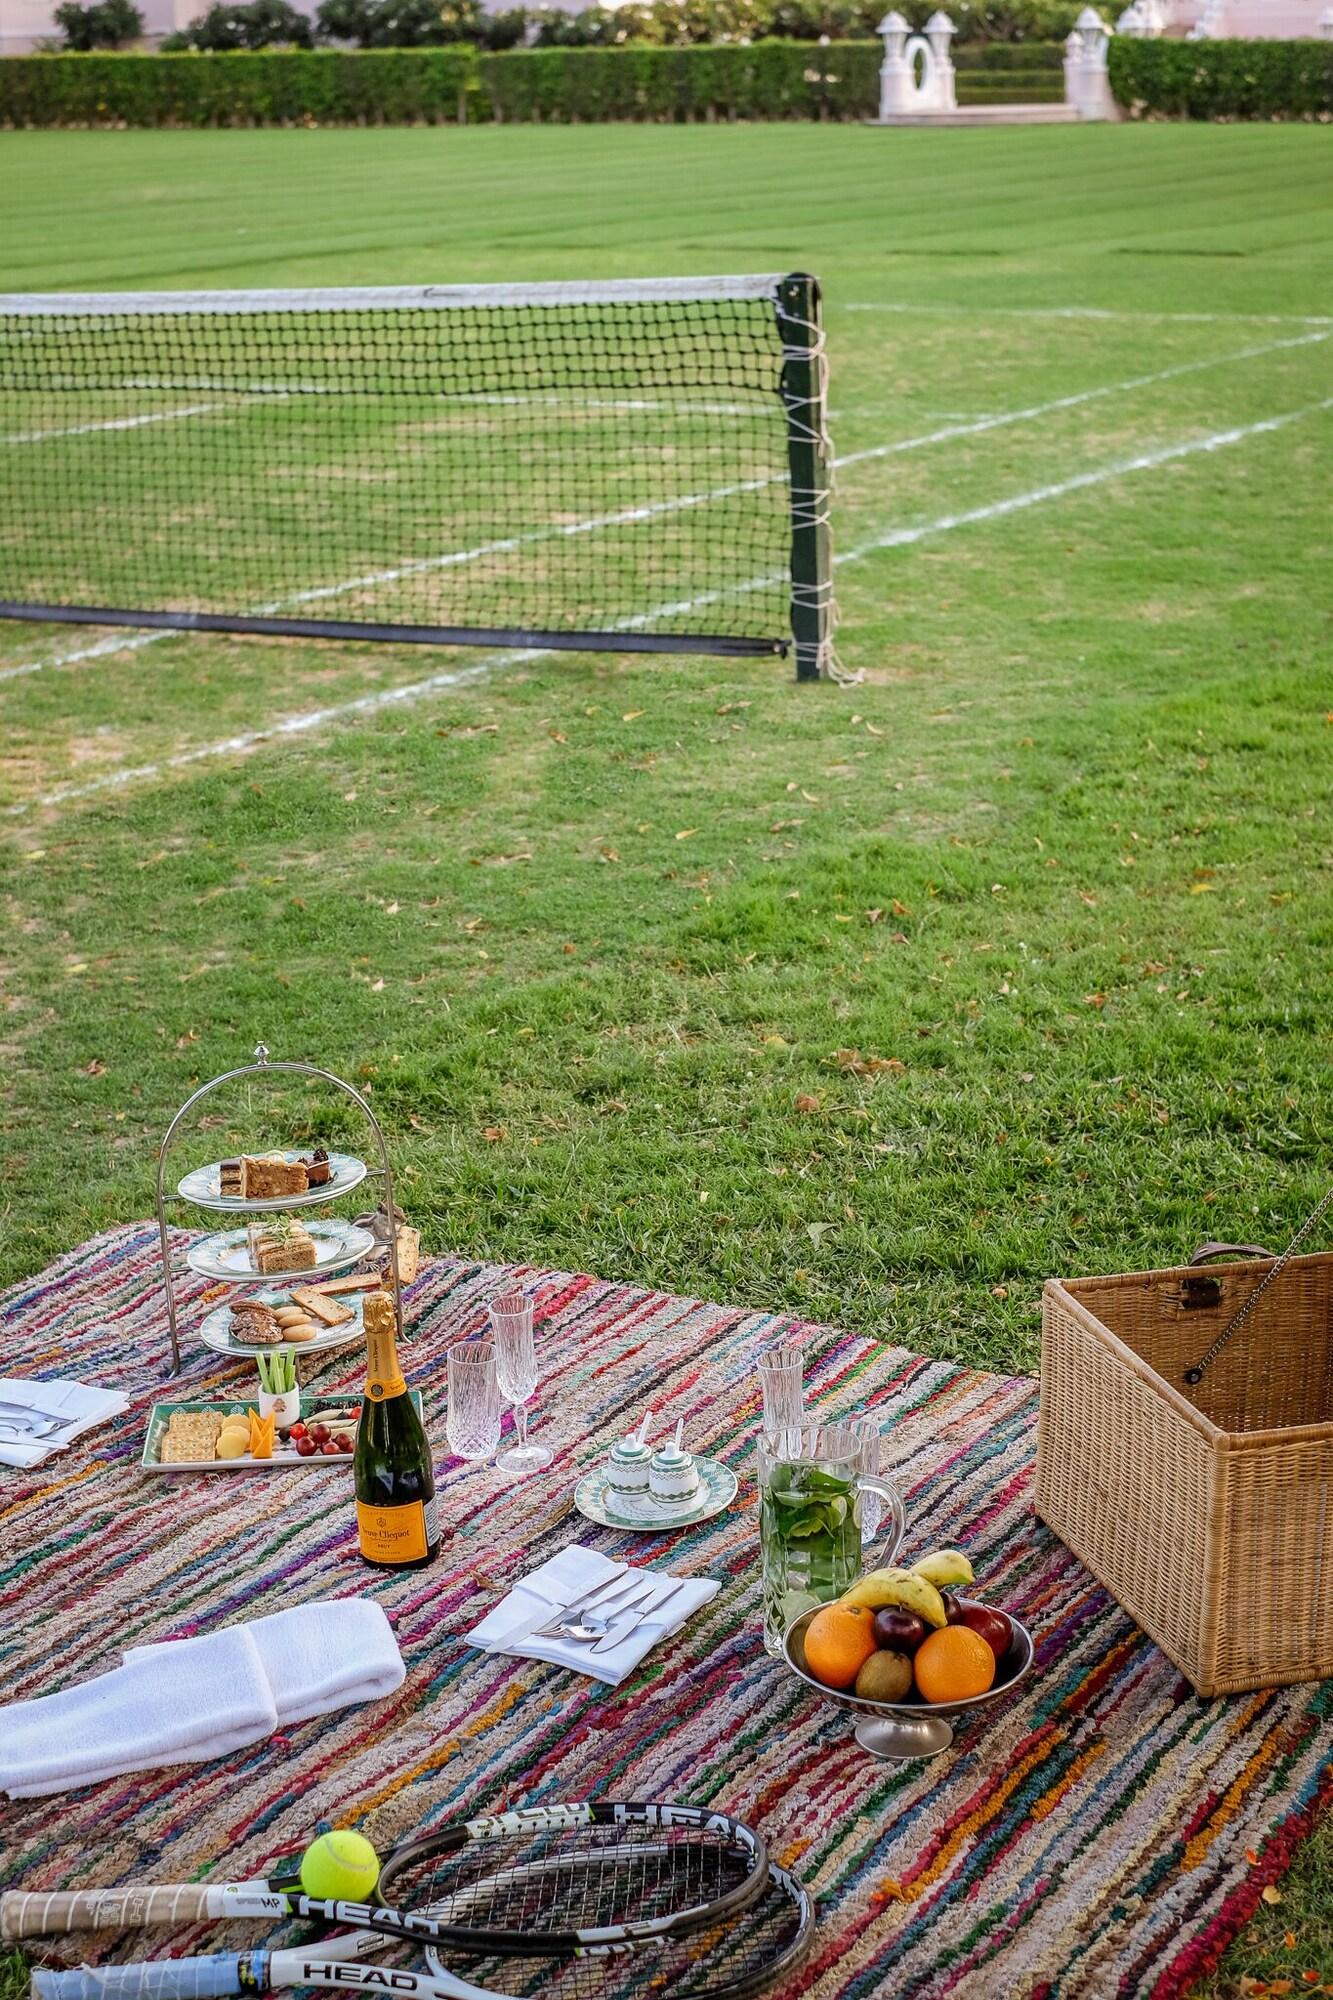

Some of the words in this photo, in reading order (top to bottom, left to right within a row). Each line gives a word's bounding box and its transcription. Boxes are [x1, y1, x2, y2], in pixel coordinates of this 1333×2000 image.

[379, 1529, 410, 1540] Clicquot
[261, 1897, 280, 1909] MP
[299, 1895, 439, 1936] HEAD
[303, 1963, 418, 1991] HEAD
